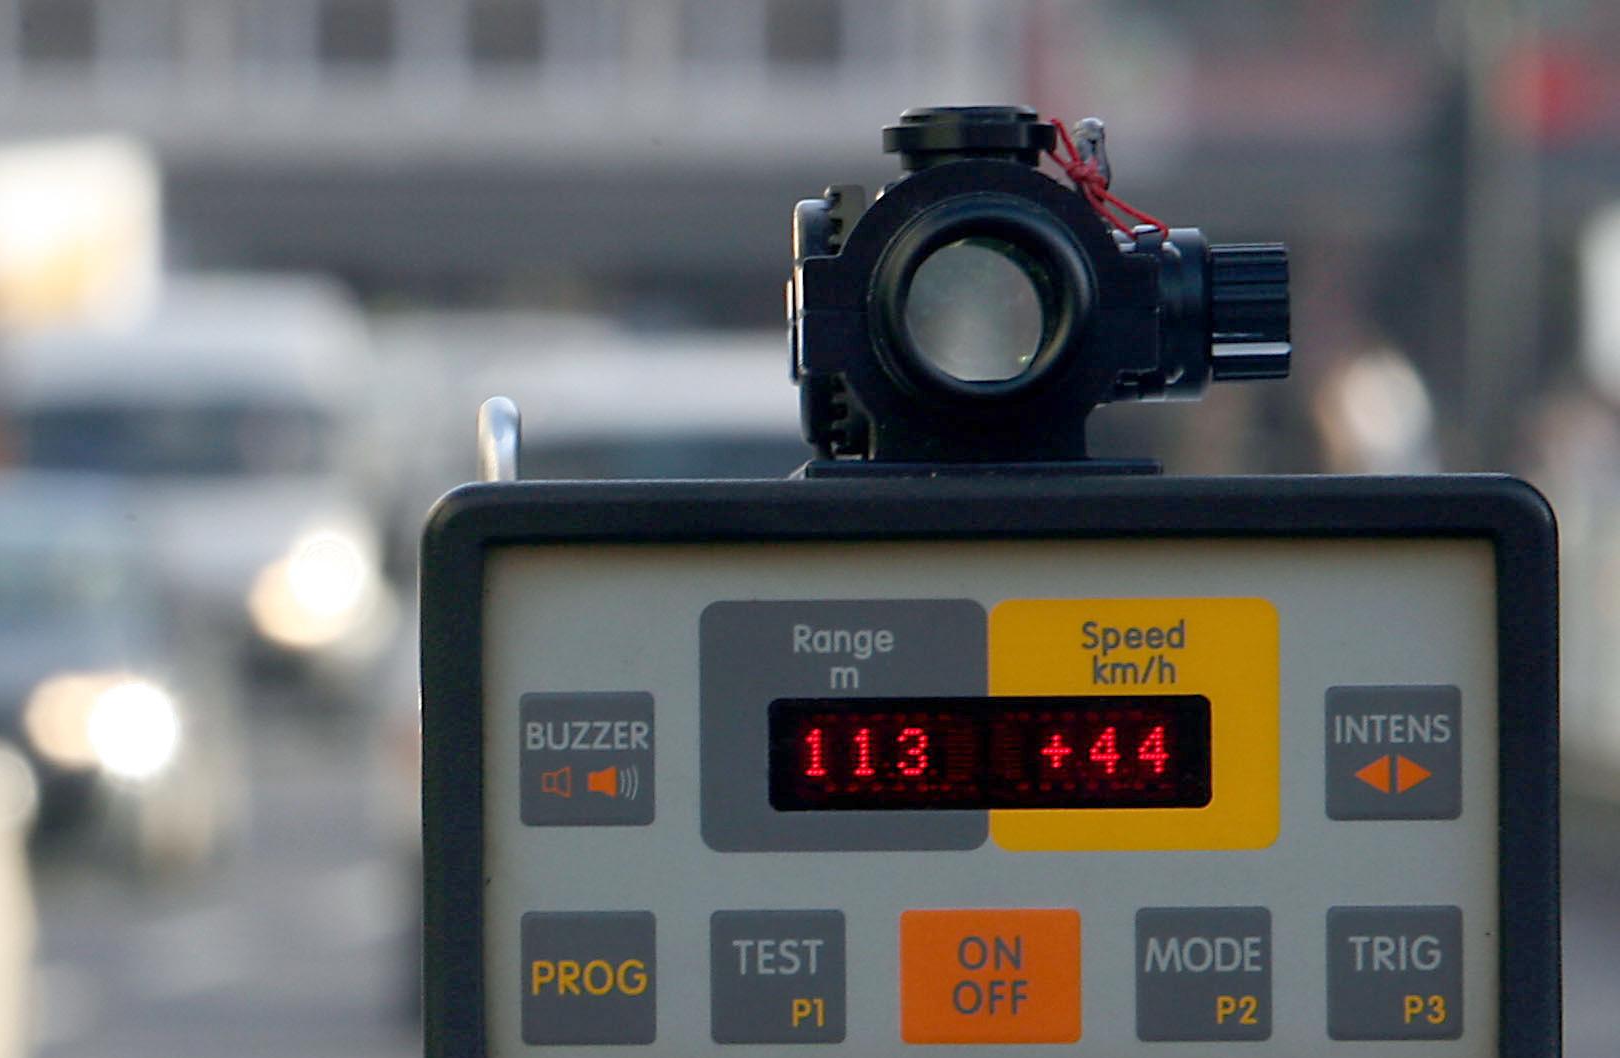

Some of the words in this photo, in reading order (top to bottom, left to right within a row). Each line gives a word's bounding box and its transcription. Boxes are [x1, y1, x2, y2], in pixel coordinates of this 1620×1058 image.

[793, 624, 894, 659] Range
[1081, 620, 1186, 656] Speed
[830, 665, 861, 690] m
[1092, 655, 1177, 686] km/h
[526, 720, 649, 751] BUZZER
[1333, 714, 1452, 745] INTENS
[806, 728, 927, 776] 113
[1041, 727, 1170, 774] +44
[733, 940, 823, 974] TEST
[957, 935, 1023, 971] ON
[1144, 936, 1263, 972] MODE
[1348, 936, 1443, 972] TRIG
[530, 960, 650, 996] PROG
[792, 997, 825, 1027] P1
[952, 980, 1029, 1016] OFF
[1215, 996, 1258, 1026] P2
[1404, 996, 1447, 1026] P3
